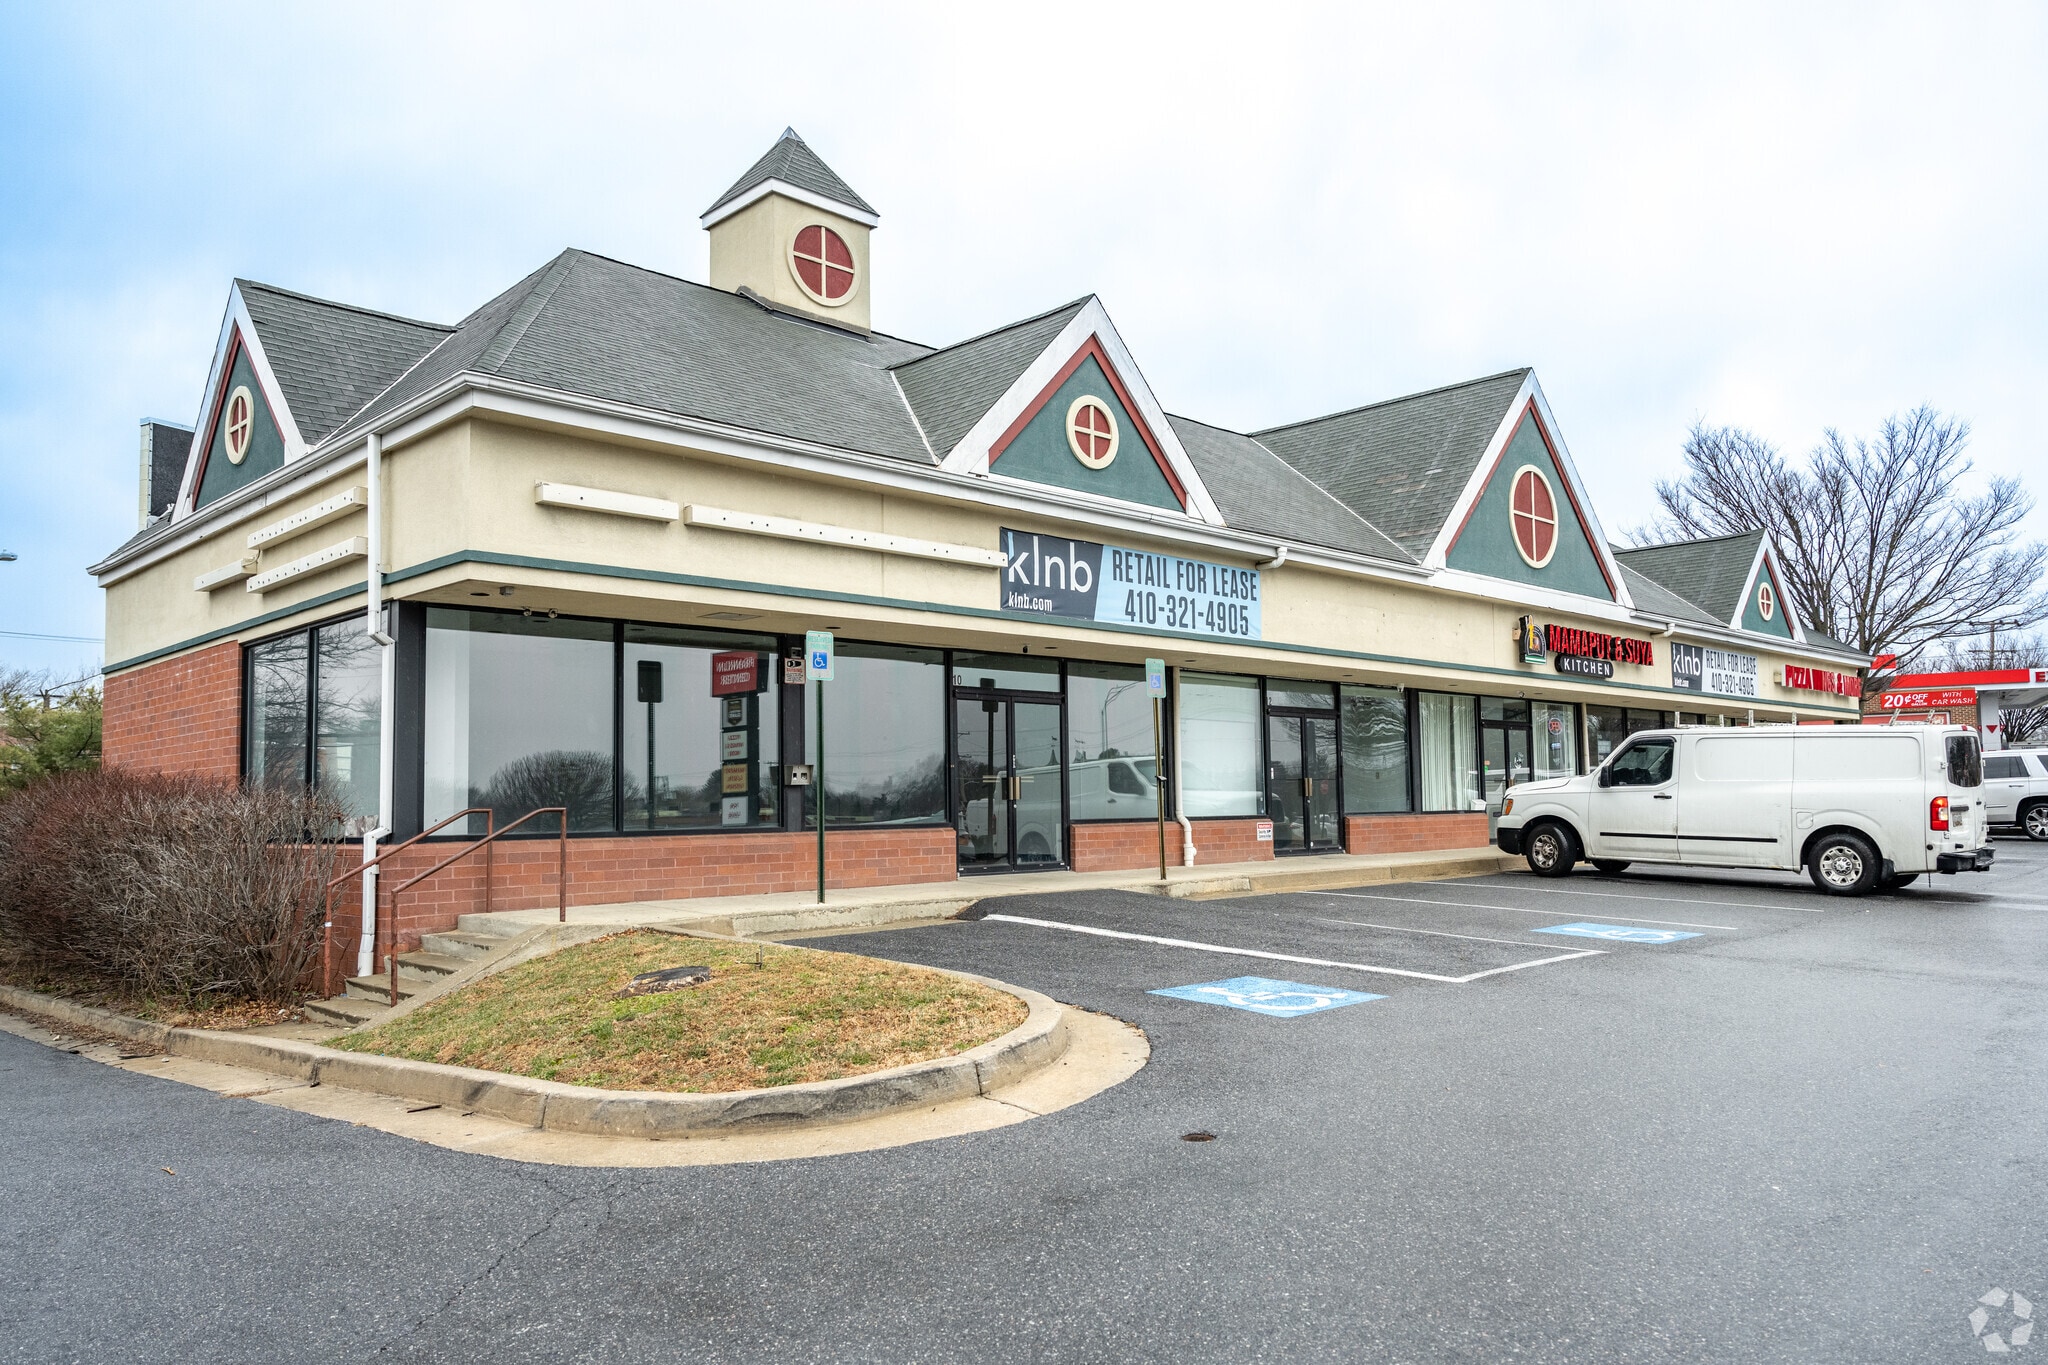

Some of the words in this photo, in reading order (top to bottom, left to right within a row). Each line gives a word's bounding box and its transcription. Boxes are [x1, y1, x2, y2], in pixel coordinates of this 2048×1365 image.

[1007, 531, 1093, 593] klnb
[1112, 549, 1170, 589] RETAIL
[1176, 560, 1207, 594] FOR
[1213, 566, 1257, 601] LEASE
[1008, 591, 1053, 612] klnb.com
[1124, 589, 1249, 636] 410-321-4905
[1549, 623, 1612, 660] MAMAPUT
[1615, 637, 1623, 661] &
[1625, 637, 1654, 666] SUYA
[1564, 658, 1611, 676] KITCHEN
[1672, 643, 1701, 676] klnb
[1705, 650, 1726, 671] RETAIL
[1728, 653, 1739, 672] FOR
[1740, 656, 1757, 675] LEASE
[1711, 672, 1754, 696] 410-321-4905
[1785, 664, 1812, 690] PIZZA
